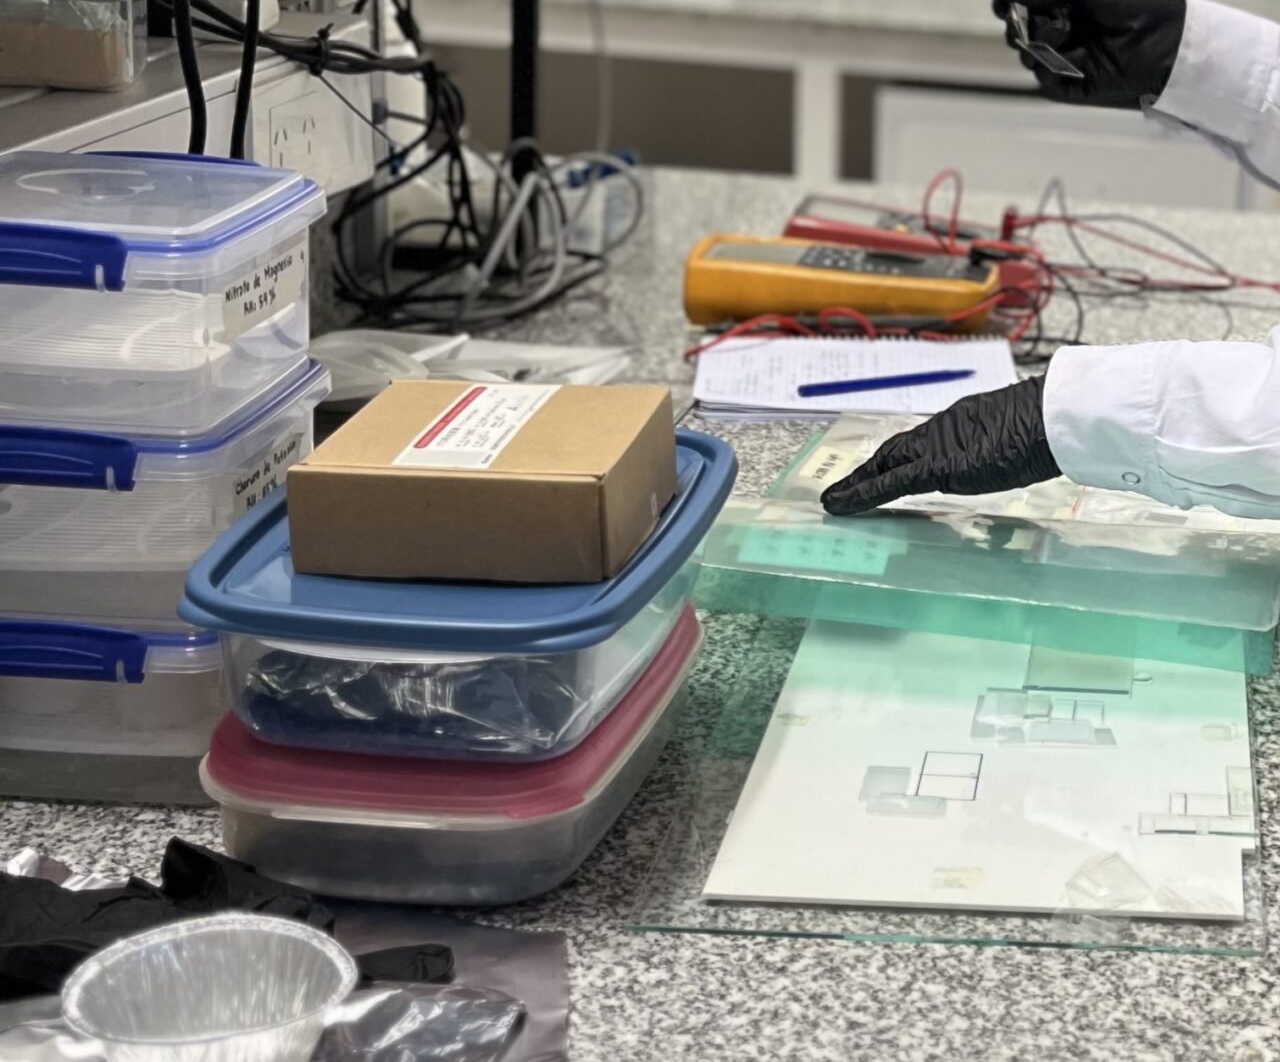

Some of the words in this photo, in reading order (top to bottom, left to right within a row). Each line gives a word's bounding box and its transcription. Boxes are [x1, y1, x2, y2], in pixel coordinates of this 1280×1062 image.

[225, 280, 250, 303] Nitrato
[253, 273, 261, 289] de
[264, 255, 293, 283] Magnesio
[263, 460, 271, 476] de
